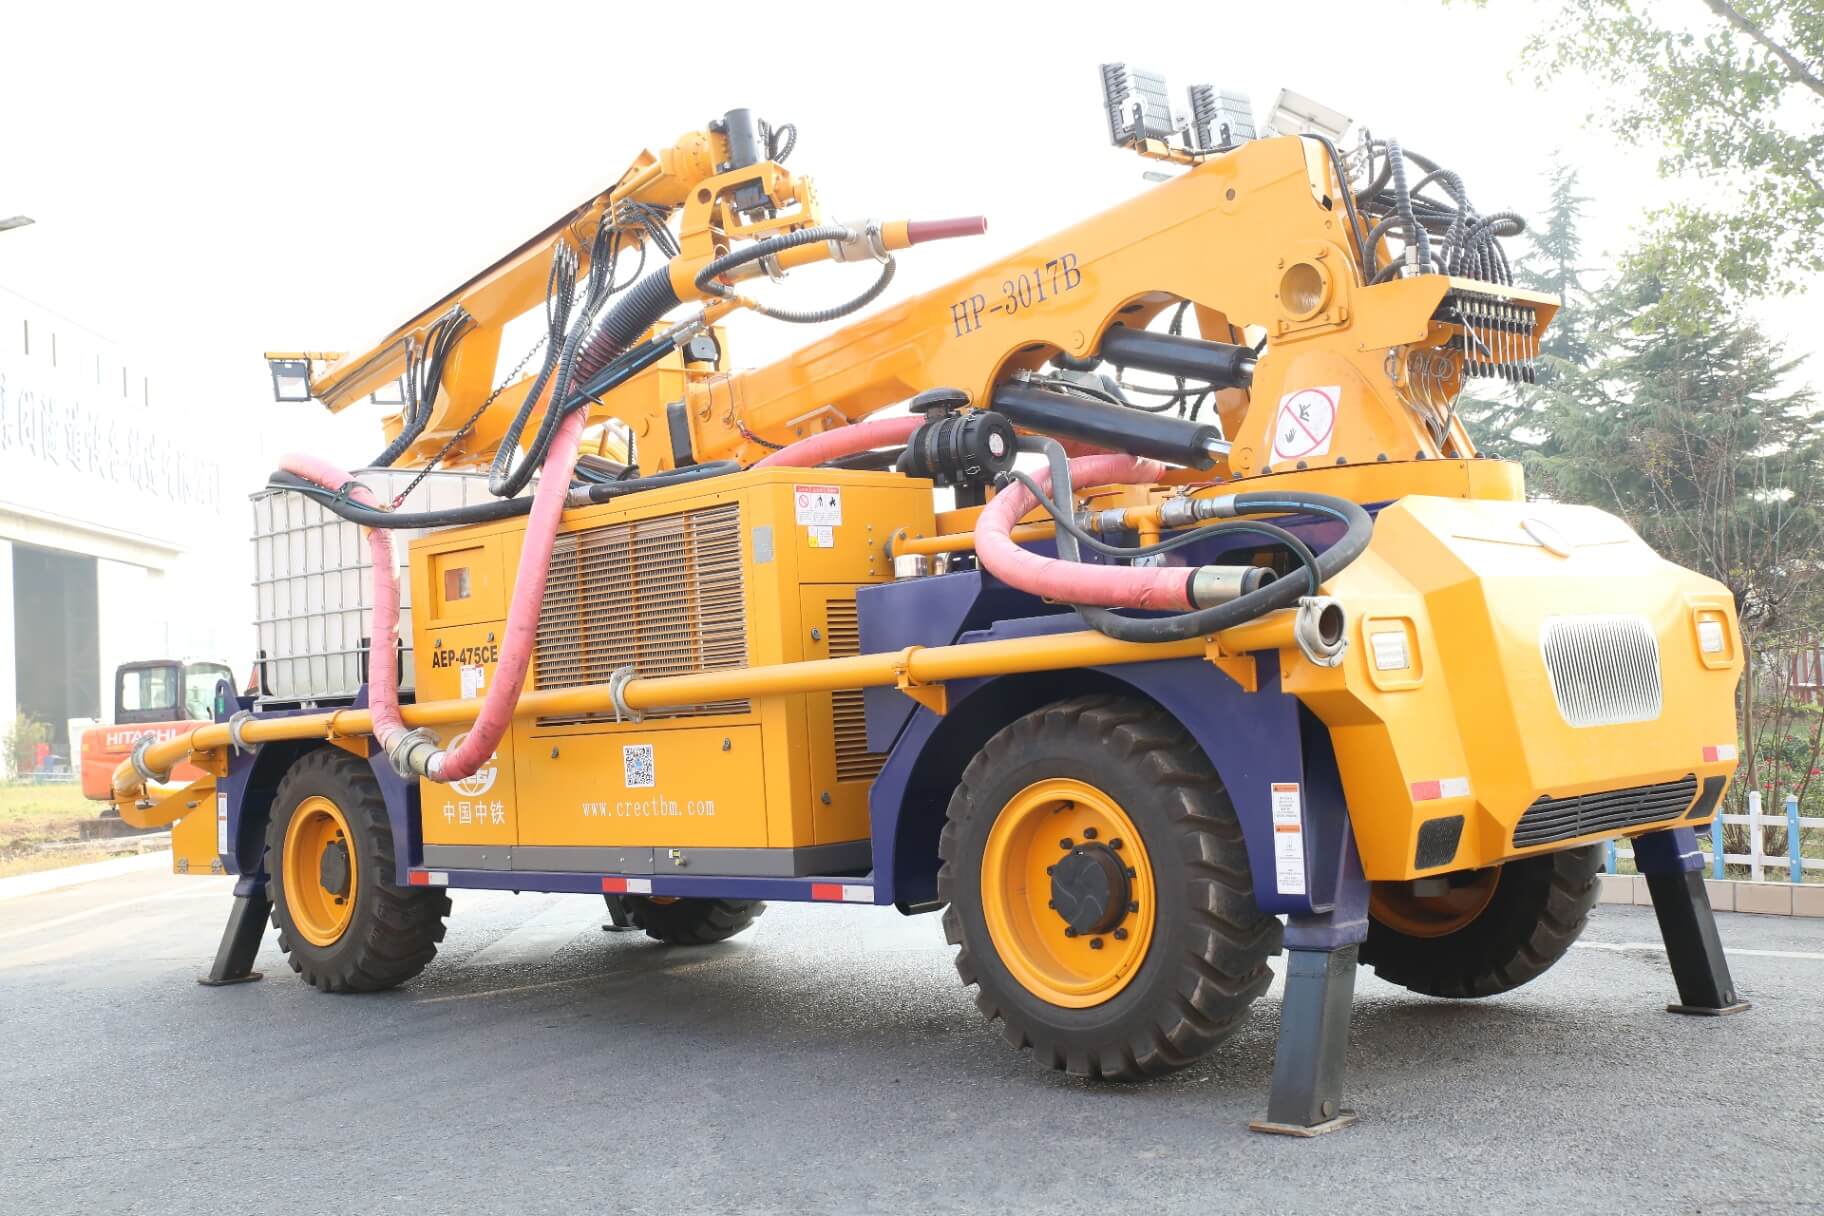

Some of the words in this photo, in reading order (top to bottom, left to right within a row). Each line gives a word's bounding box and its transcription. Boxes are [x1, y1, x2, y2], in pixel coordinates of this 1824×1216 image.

[949, 252, 1081, 338] HP-3017B
[432, 645, 498, 668] AEP-475CE
[443, 799, 505, 825] 中国中铁
[582, 794, 715, 817] www.crectbm.com
